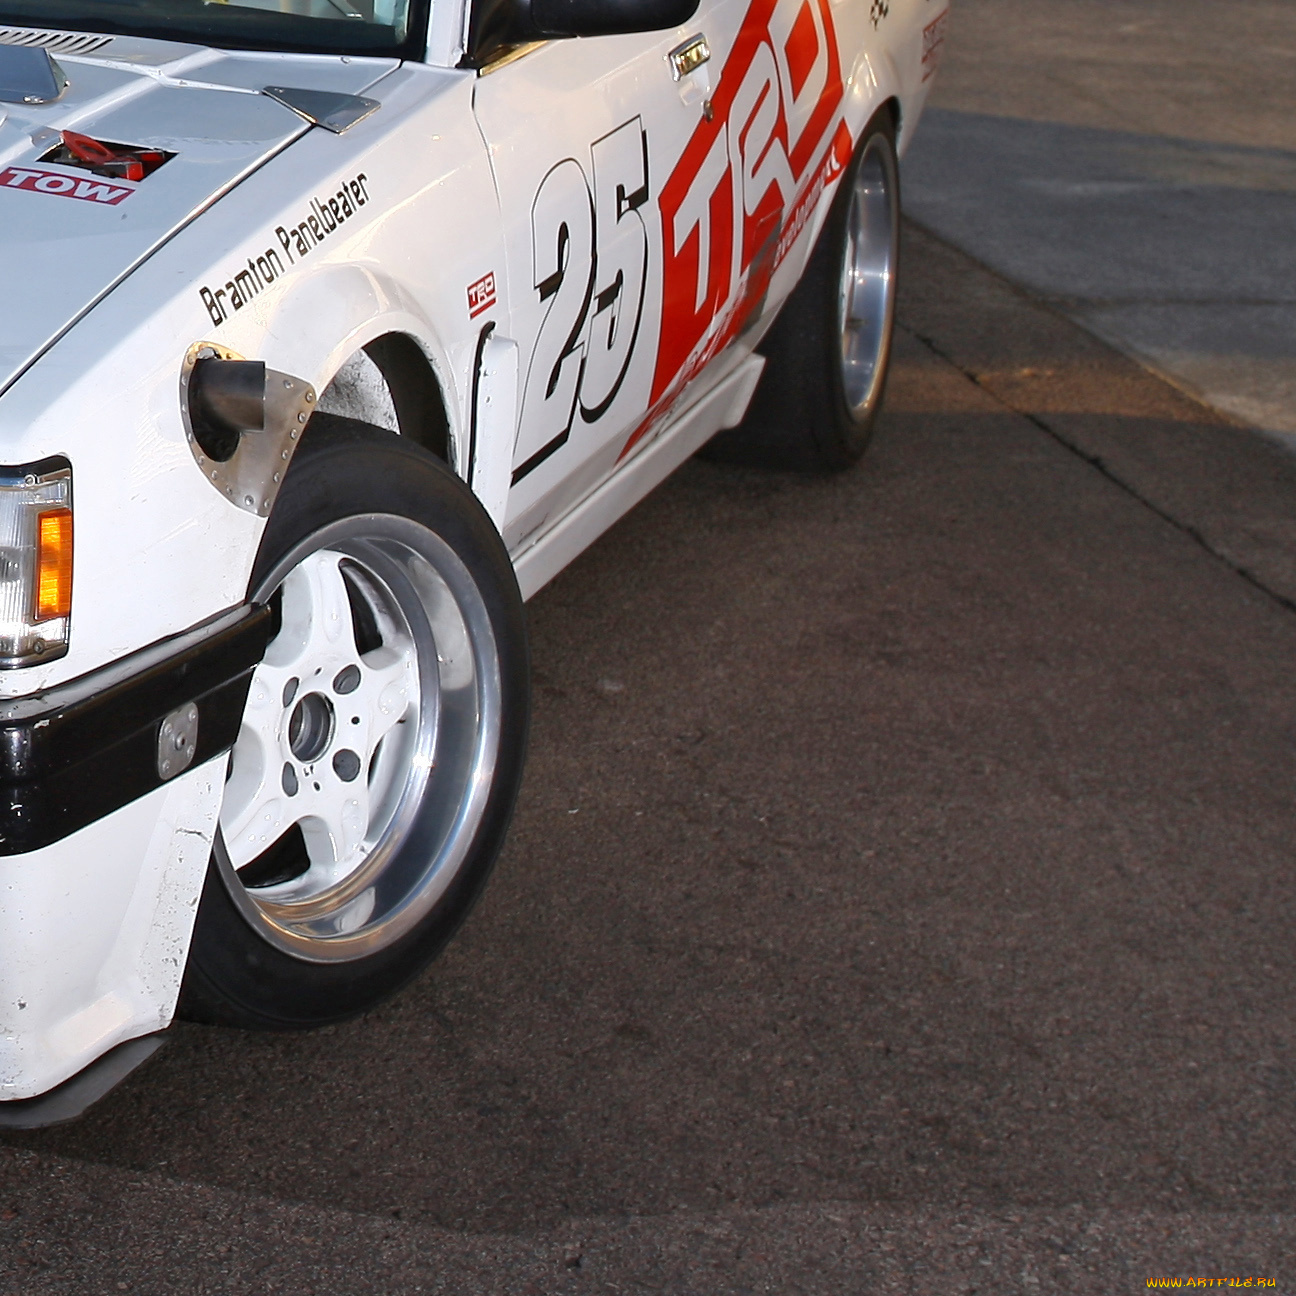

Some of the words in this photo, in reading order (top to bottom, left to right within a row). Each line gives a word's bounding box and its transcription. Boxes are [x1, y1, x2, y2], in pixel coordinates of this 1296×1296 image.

[3, 169, 130, 203] TOW
[198, 247, 285, 328] Bramton
[275, 172, 371, 265] Panelbeater
[511, 114, 649, 485] 25
